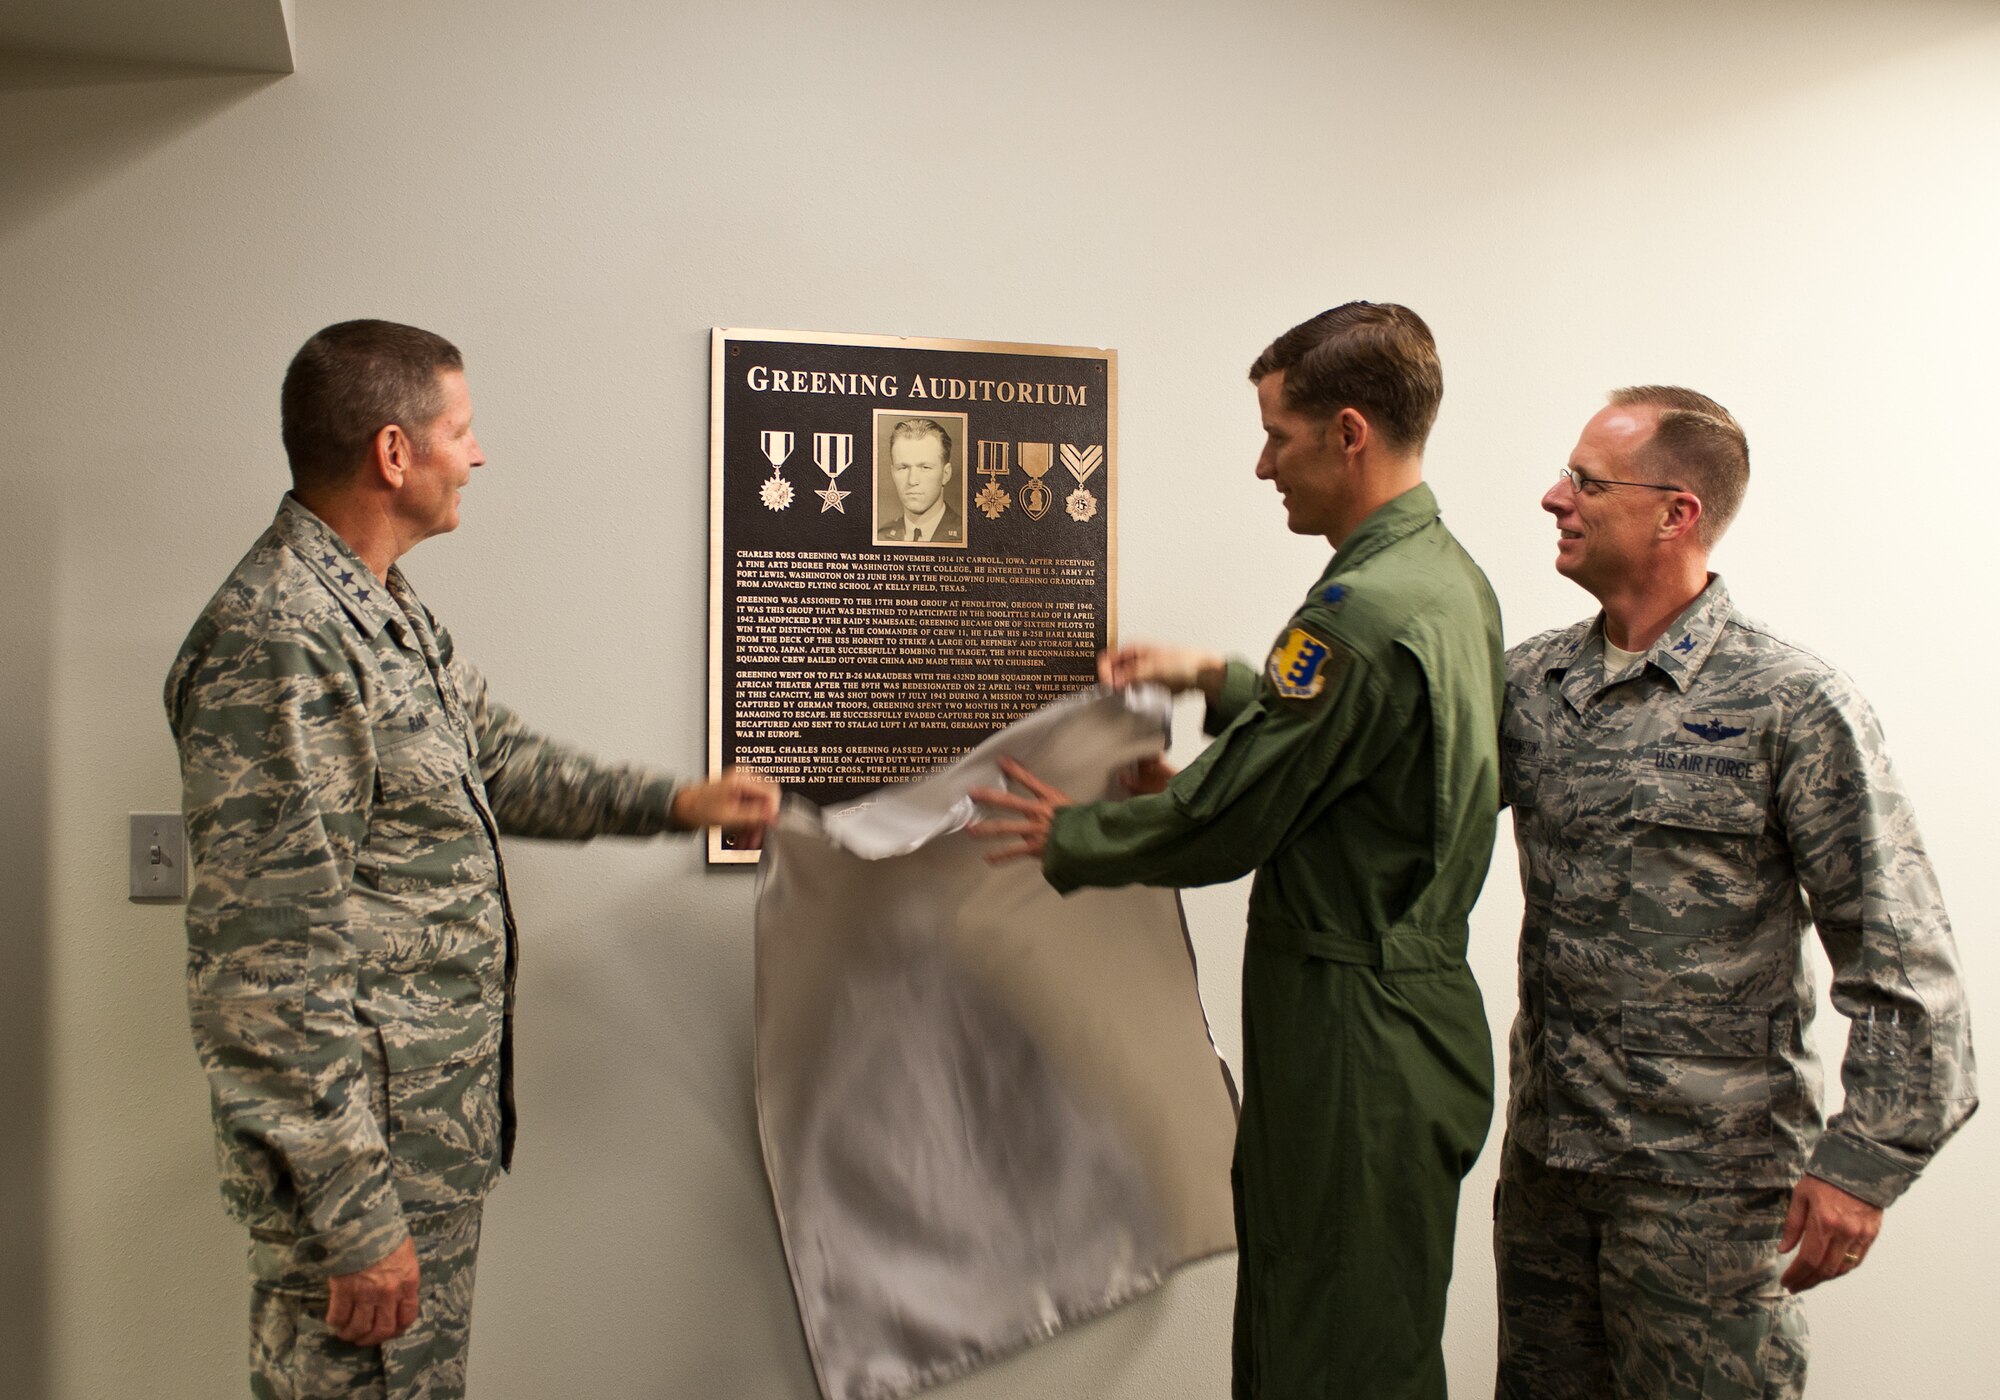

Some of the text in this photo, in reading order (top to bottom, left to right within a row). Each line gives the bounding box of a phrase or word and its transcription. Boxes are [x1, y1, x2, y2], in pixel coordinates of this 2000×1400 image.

[747, 366, 1088, 406] GREENING AUDITORIUM
[966, 556, 1003, 565] CARROLL,
[852, 564, 904, 572] WASHINGTON
[933, 565, 971, 574] COLLEGE,
[760, 571, 787, 579] LEWIS,
[789, 572, 841, 580] WASHINGTON
[986, 576, 1007, 584] JUNE,
[913, 584, 937, 592] FIELD,
[962, 601, 1009, 609] PENDLETON,
[872, 618, 917, 626] NAMESAKE;
[736, 656, 780, 664] SQUADRON
[1001, 674, 1042, 682] SQUADRON
[1006, 712, 1033, 720] MONT
[1678, 754, 1702, 772] AIR
[1705, 758, 1755, 779] FORCE
